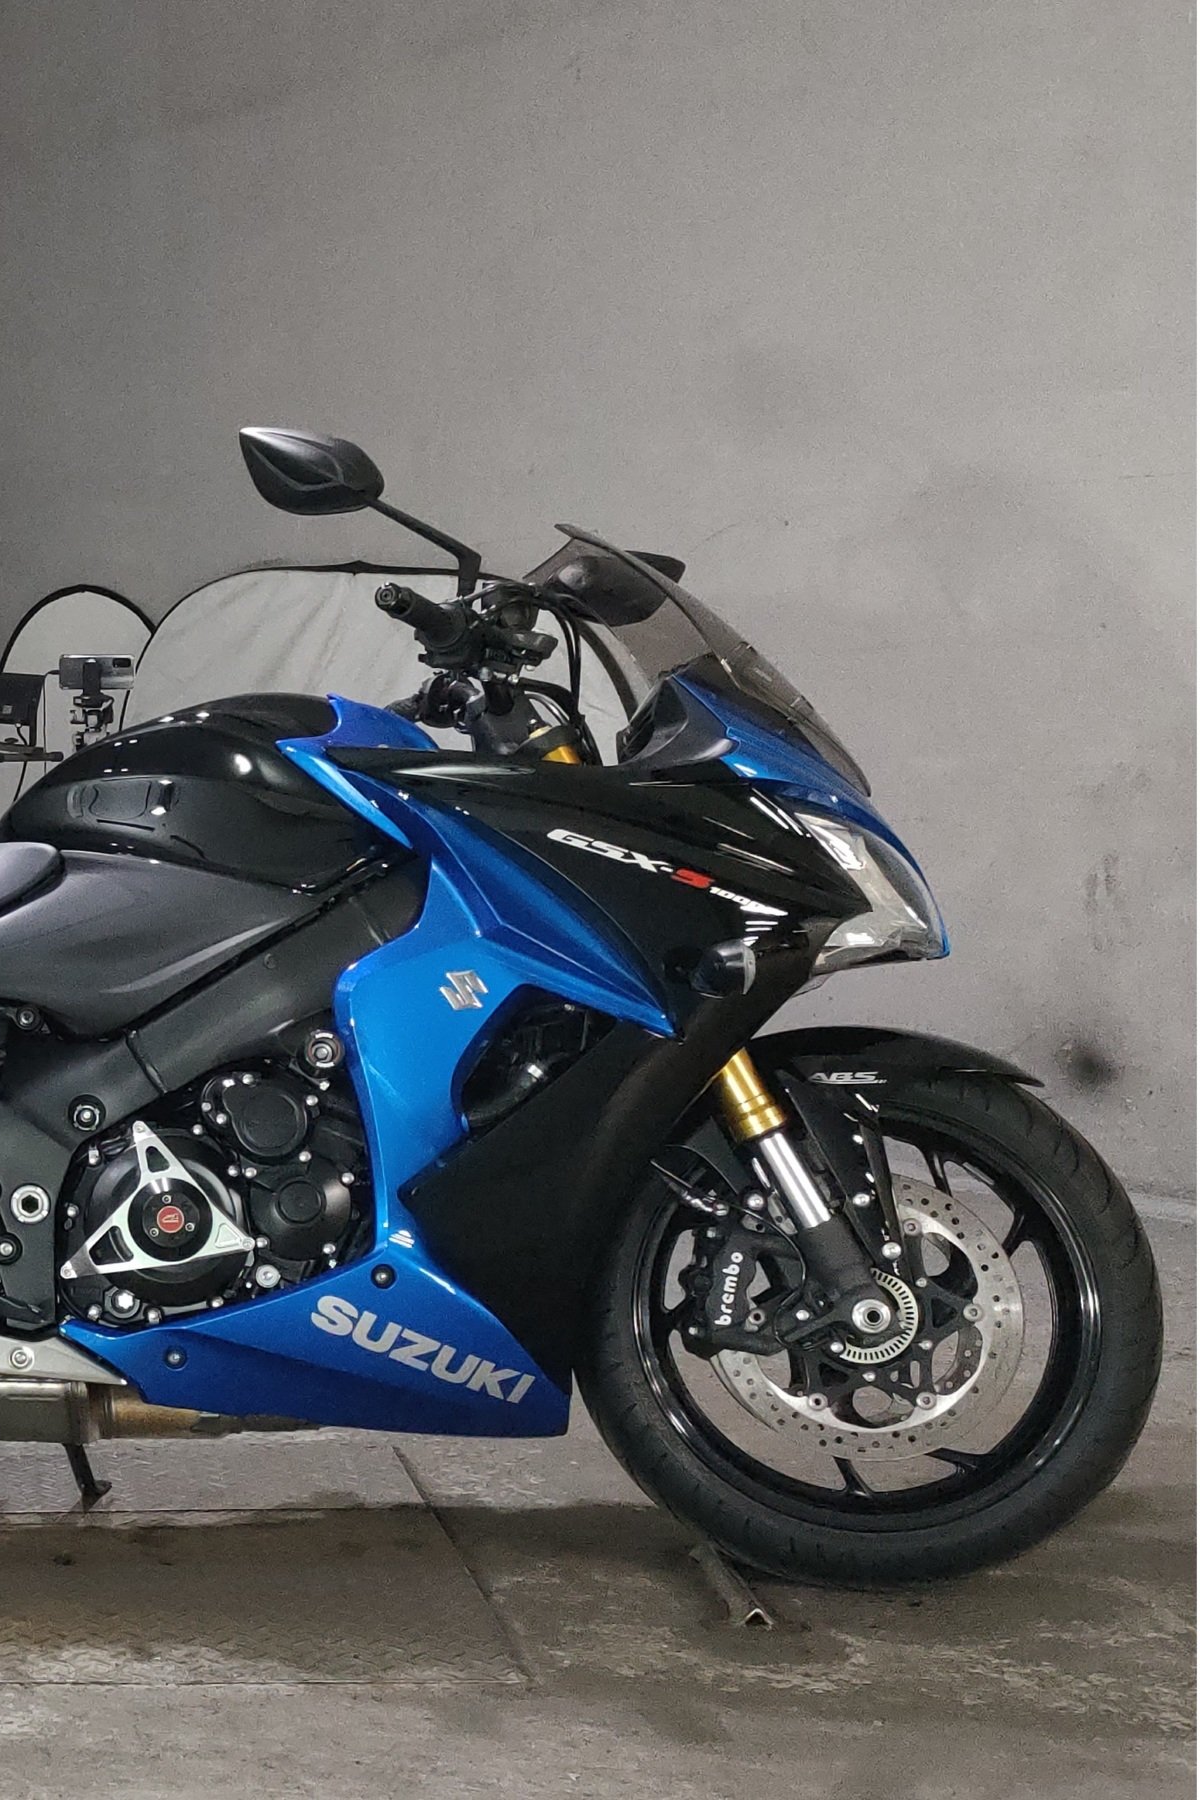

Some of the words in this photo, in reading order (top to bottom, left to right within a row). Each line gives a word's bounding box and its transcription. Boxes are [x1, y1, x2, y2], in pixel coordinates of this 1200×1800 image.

[547, 828, 714, 888] GSX-S
[808, 1071, 879, 1082] ABS
[714, 1251, 743, 1326] brembo
[311, 1295, 535, 1404] SUZUKI
